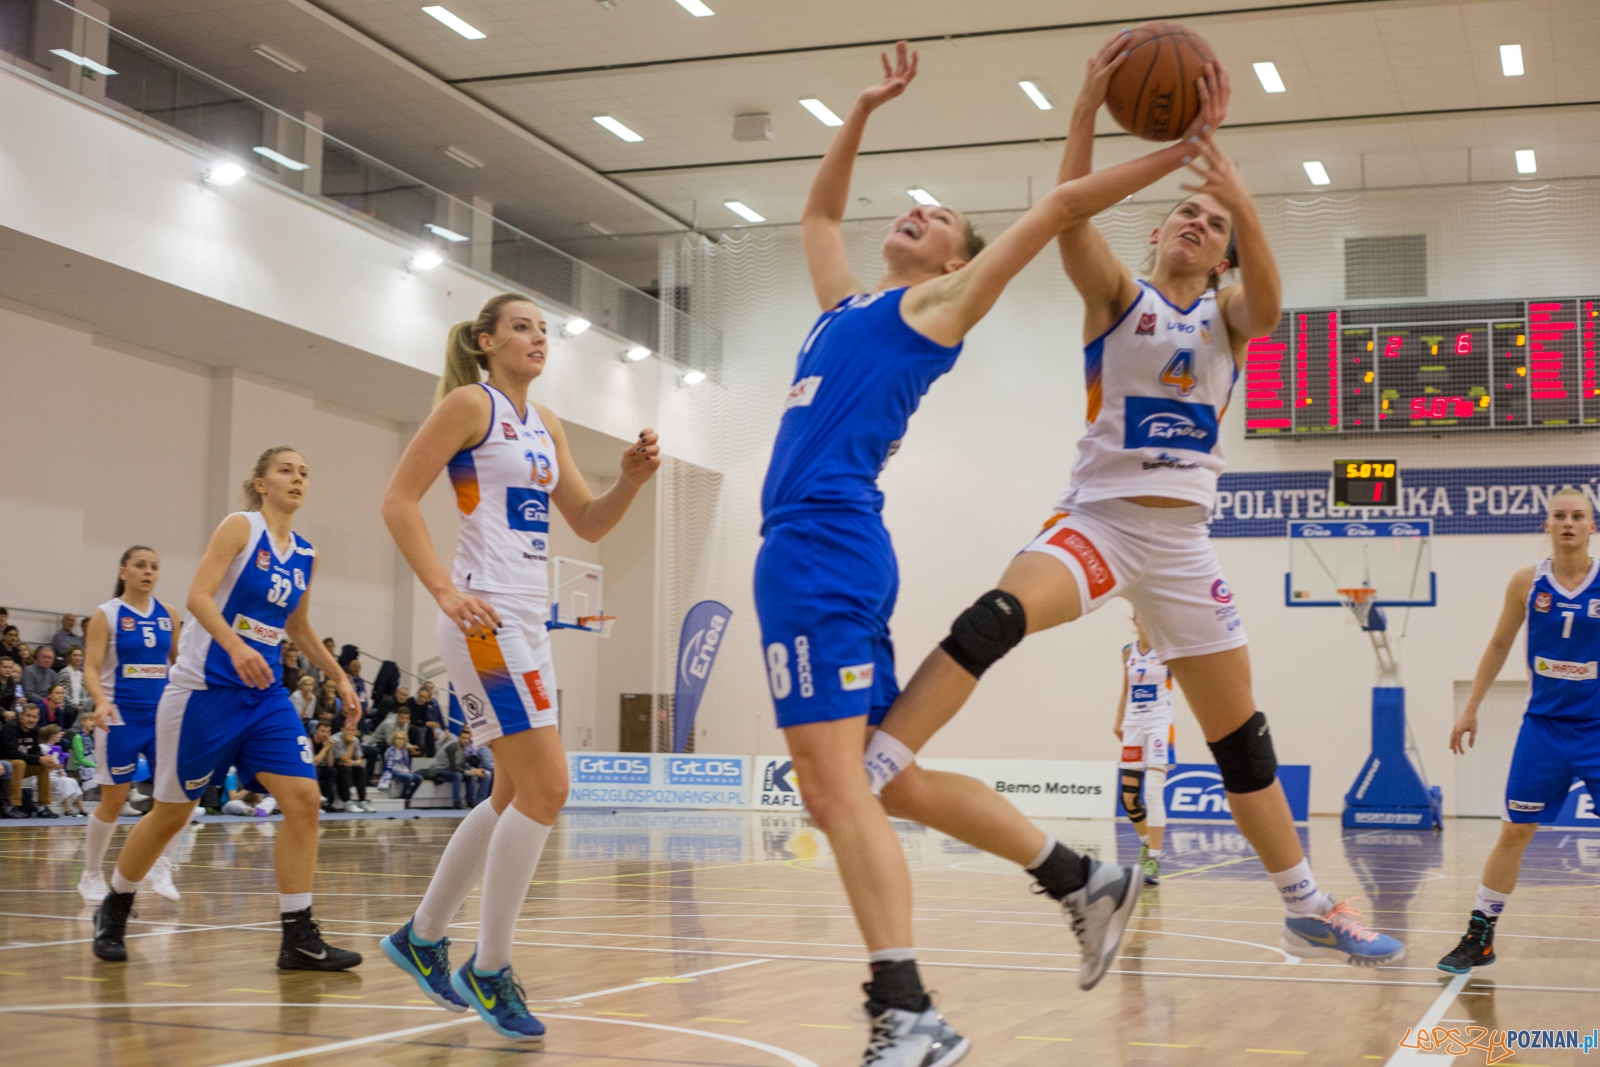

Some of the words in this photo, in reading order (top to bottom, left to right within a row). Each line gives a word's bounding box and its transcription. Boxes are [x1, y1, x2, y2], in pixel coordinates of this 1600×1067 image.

[1455, 333, 1472, 355] 6
[1160, 348, 1198, 397] 4
[525, 449, 554, 488] 13
[1373, 481, 1383, 502] 1
[266, 573, 292, 608] 32
[142, 626, 157, 648] 5
[1561, 611, 1575, 639] 1
[689, 614, 726, 680] Enea
[767, 642, 792, 700] 8
[1136, 668, 1147, 683] 7
[761, 793, 804, 806] RAFL
[994, 781, 1042, 794] Bemo
[1044, 782, 1103, 795] Motors
